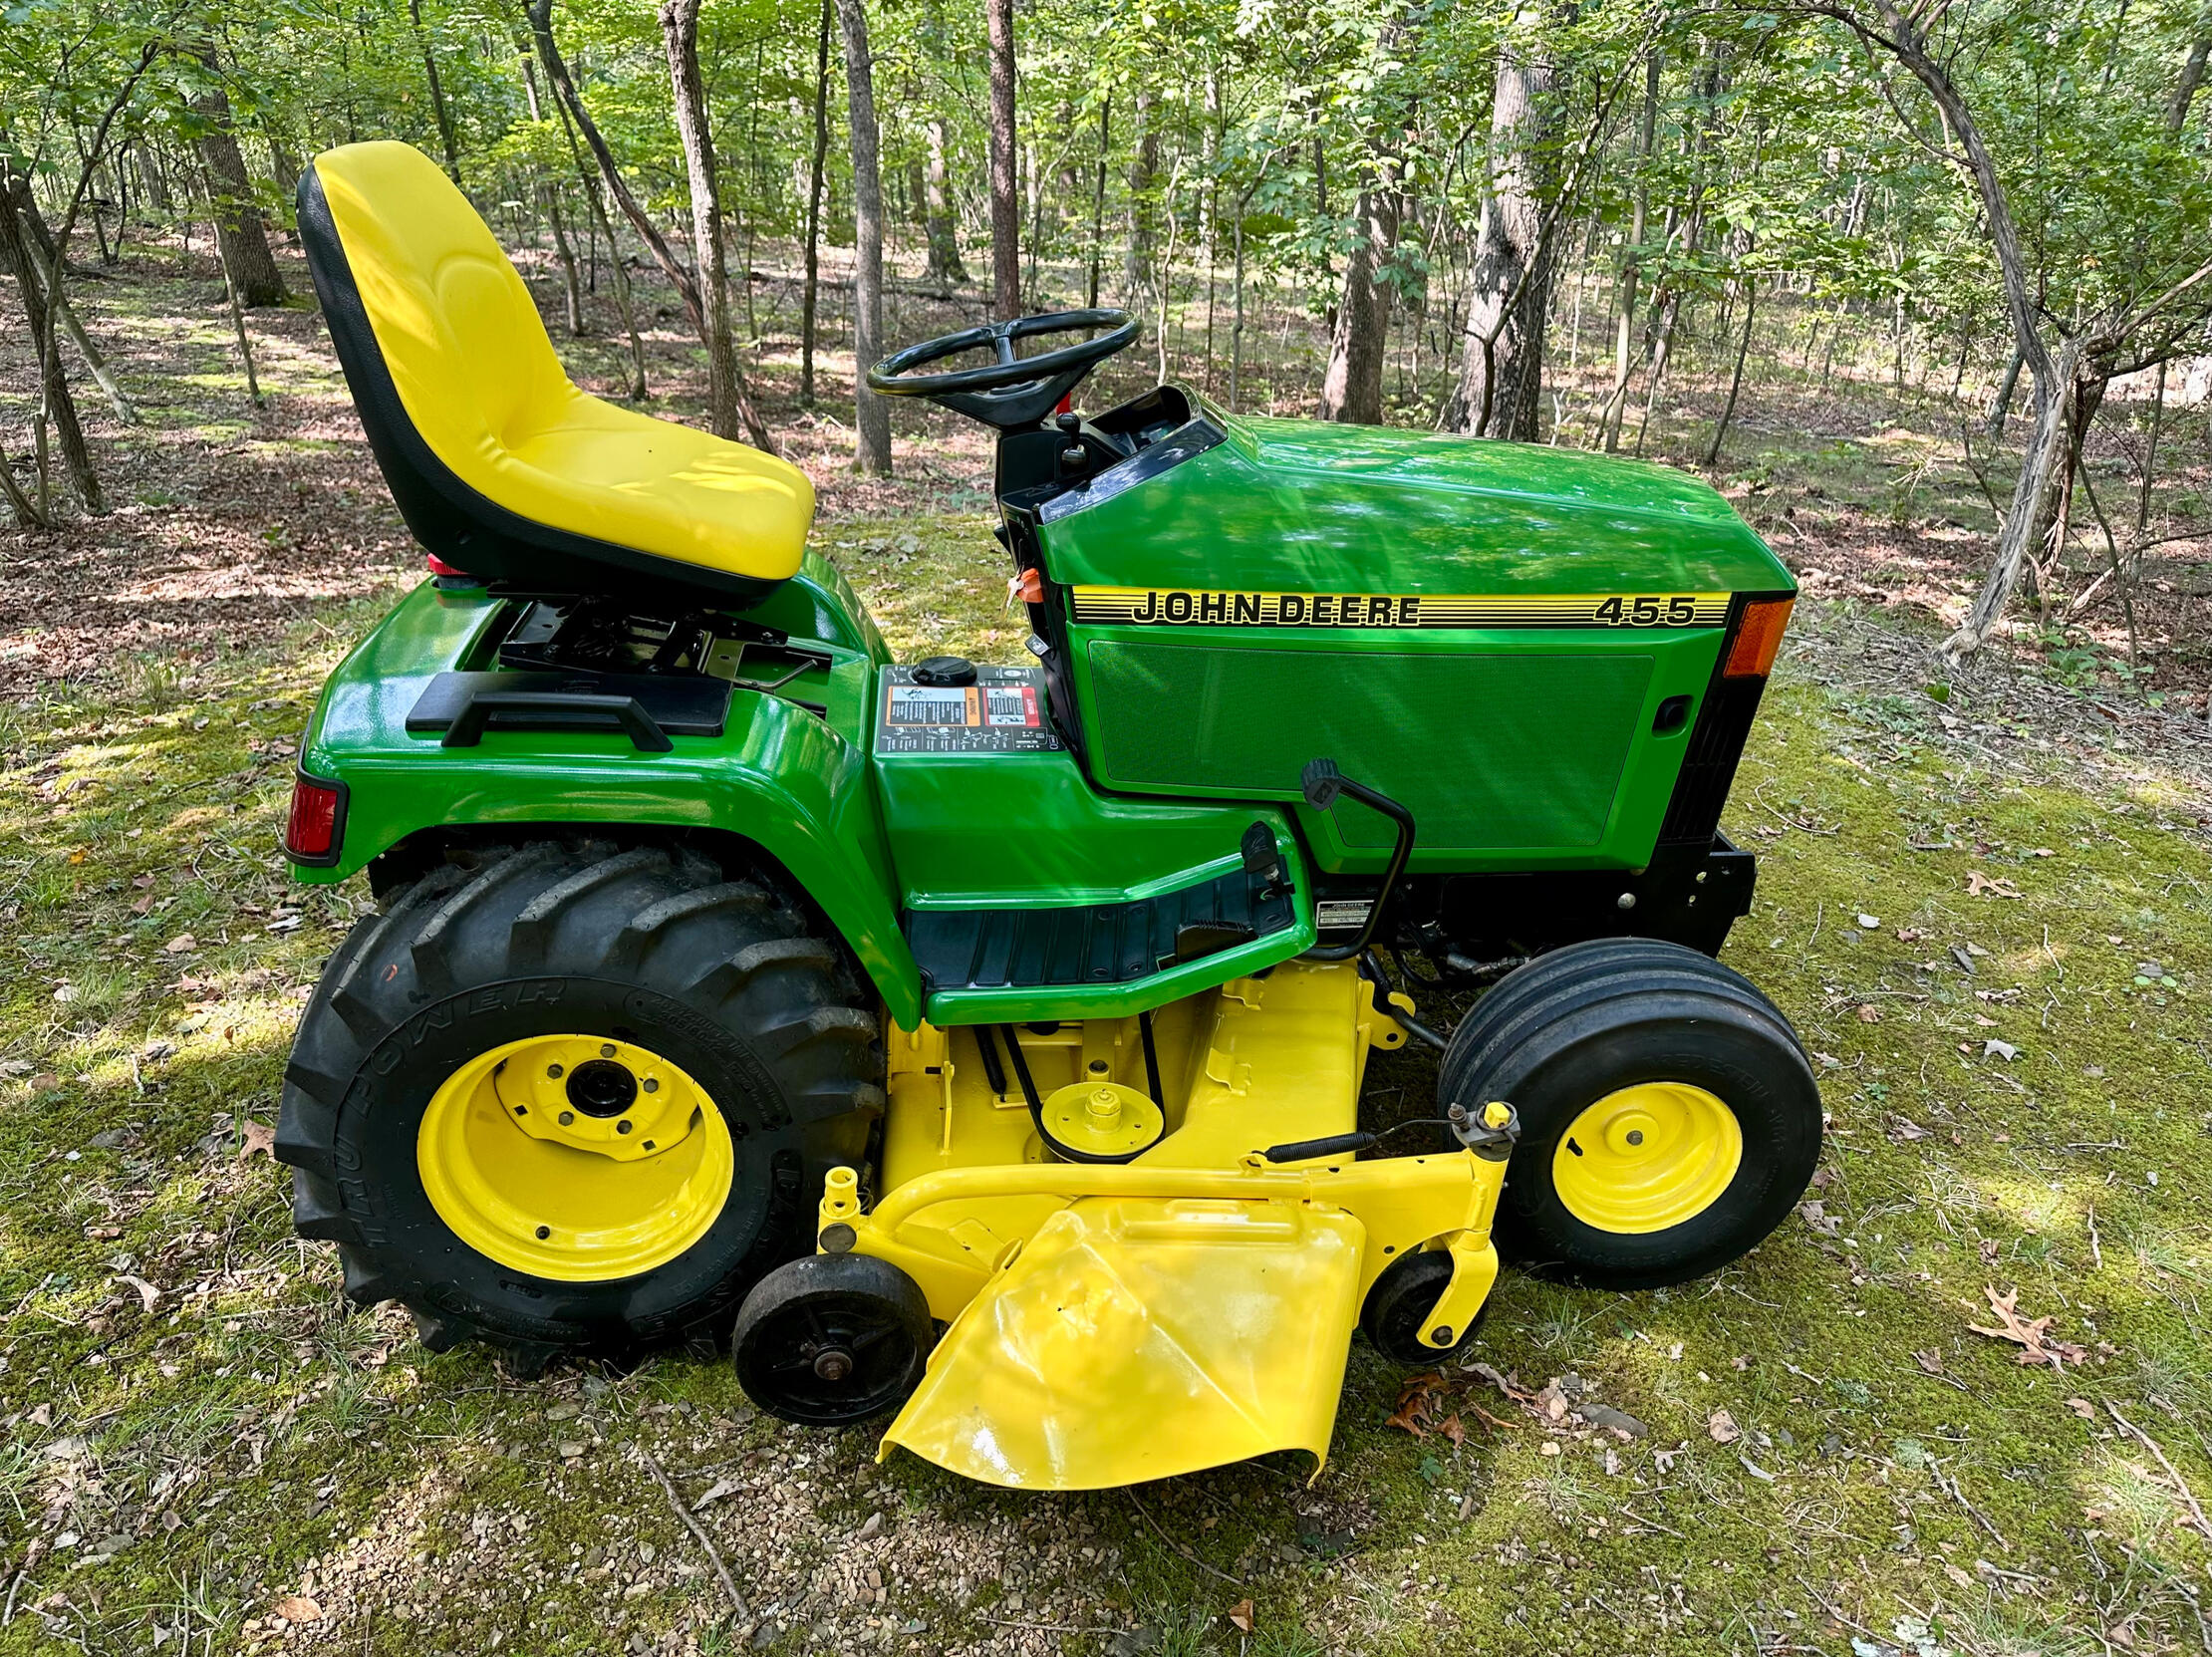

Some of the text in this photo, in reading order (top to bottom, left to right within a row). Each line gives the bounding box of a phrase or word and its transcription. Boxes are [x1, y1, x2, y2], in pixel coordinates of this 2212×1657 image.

[1133, 592, 1422, 627] JOHN DEERE
[1593, 597, 1696, 627] 455
[333, 976, 566, 1247] TRU POWER
